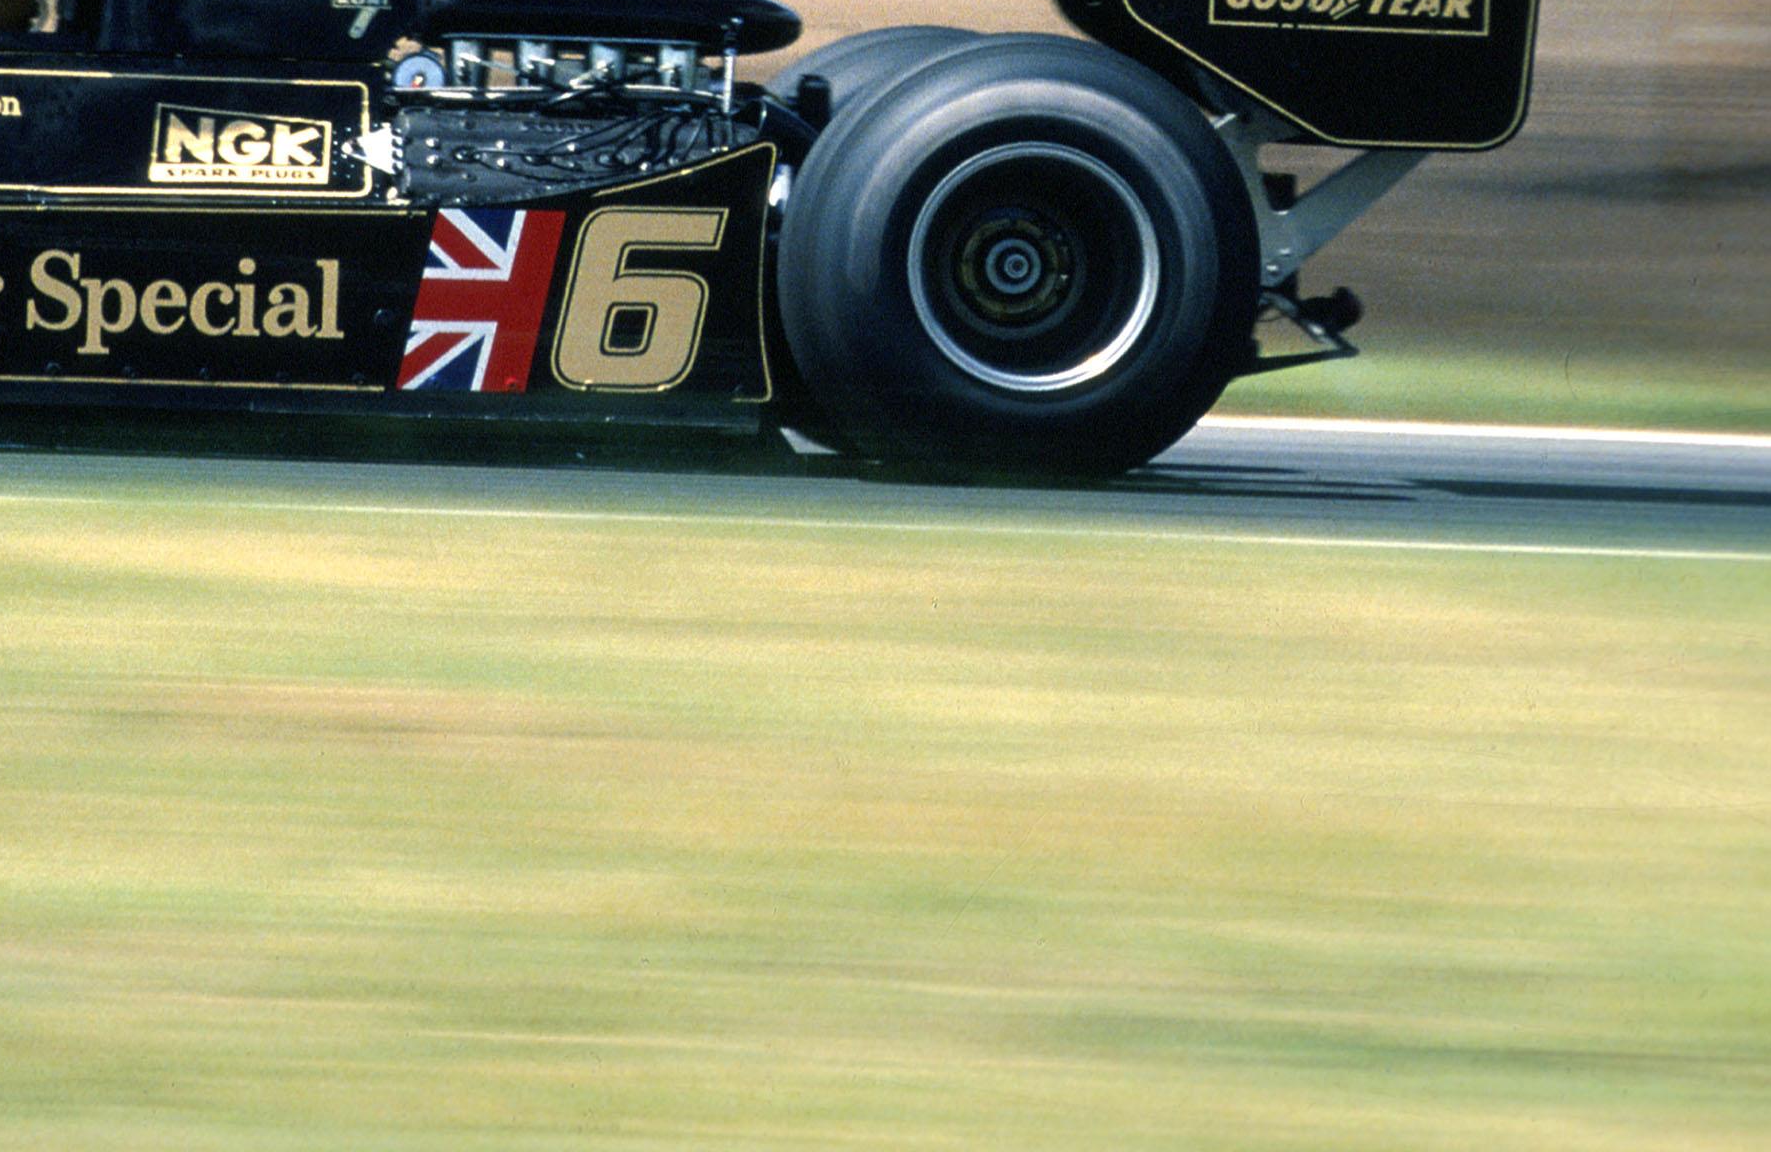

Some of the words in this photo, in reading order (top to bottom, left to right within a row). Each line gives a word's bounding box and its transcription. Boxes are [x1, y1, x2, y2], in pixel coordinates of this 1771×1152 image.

[165, 112, 322, 166] NGK
[166, 167, 237, 178] SPARK
[250, 169, 316, 179] PLUGS
[26, 249, 345, 355] Special
[554, 207, 728, 393] 6
